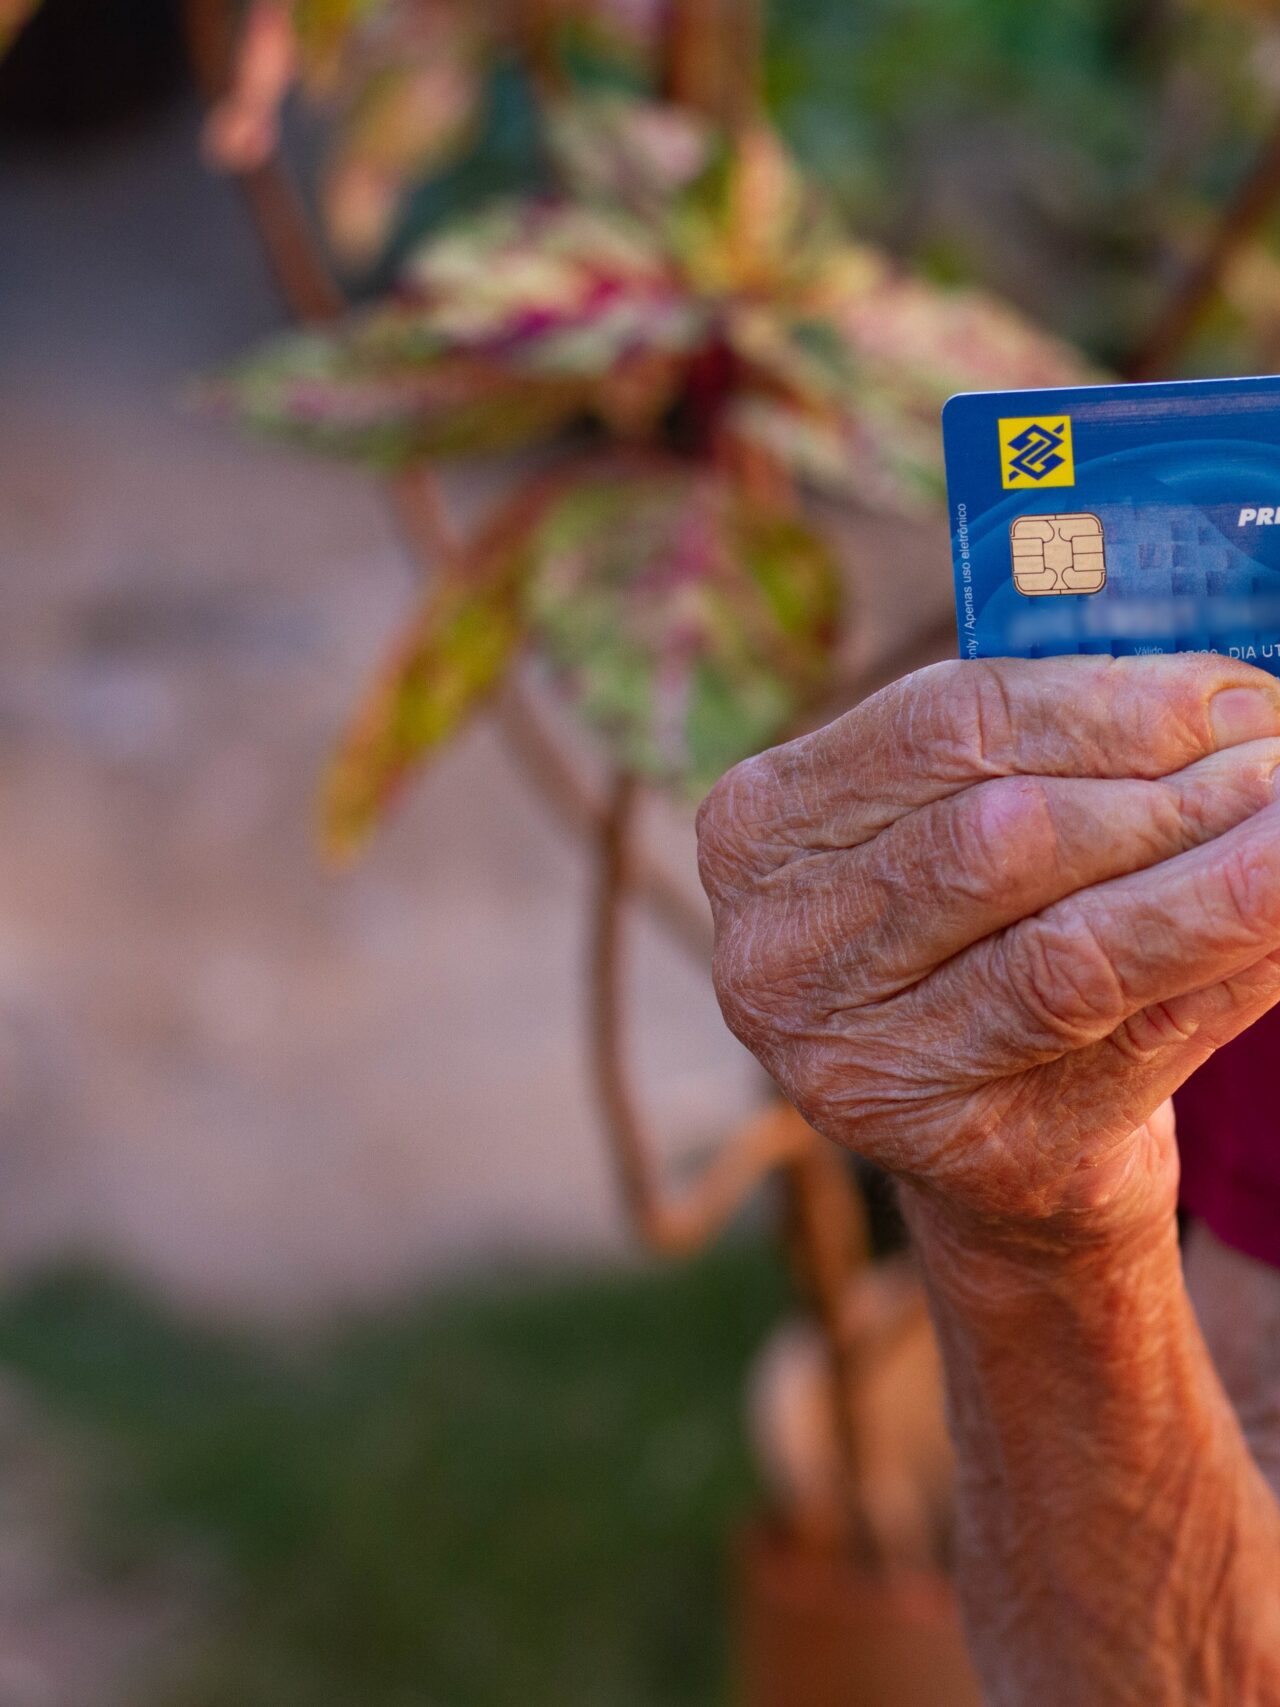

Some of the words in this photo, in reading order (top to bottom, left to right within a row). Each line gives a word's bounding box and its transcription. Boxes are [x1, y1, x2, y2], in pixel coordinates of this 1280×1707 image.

[956, 503, 970, 559] eletrônico
[962, 562, 972, 583] uso
[963, 586, 976, 629] Apenas
[1229, 646, 1256, 659] DIA
